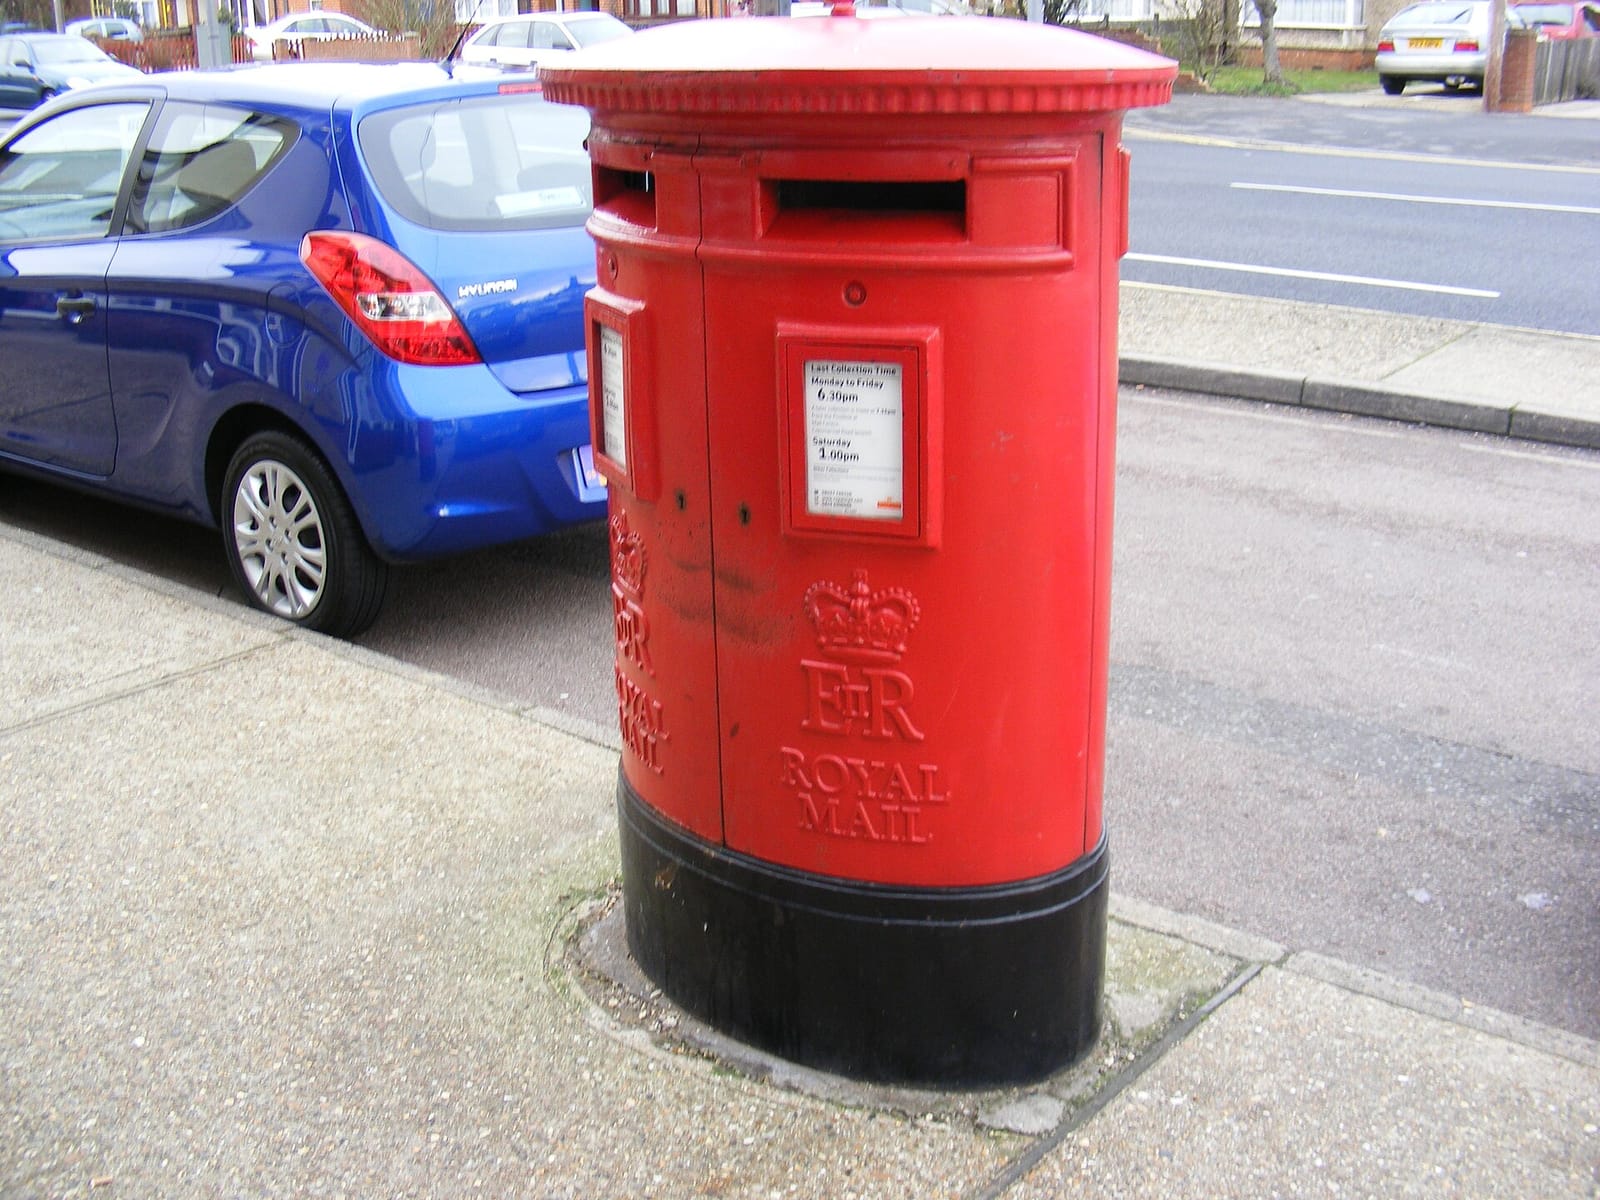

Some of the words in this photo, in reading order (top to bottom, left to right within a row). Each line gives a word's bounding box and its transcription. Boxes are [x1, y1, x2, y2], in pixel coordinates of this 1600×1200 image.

[459, 279, 517, 297] HYUNDAI
[811, 363, 829, 373] Last
[831, 364, 873, 375] Collection
[876, 366, 897, 376] Time
[811, 376, 844, 388] Monday
[846, 379, 855, 387] to
[857, 378, 884, 390] Friday
[817, 387, 859, 403] 6.30pm
[812, 436, 851, 448] Saturday
[819, 447, 860, 462] 1.00pm
[781, 746, 951, 803] ROYAL
[797, 792, 934, 843] MAIL
